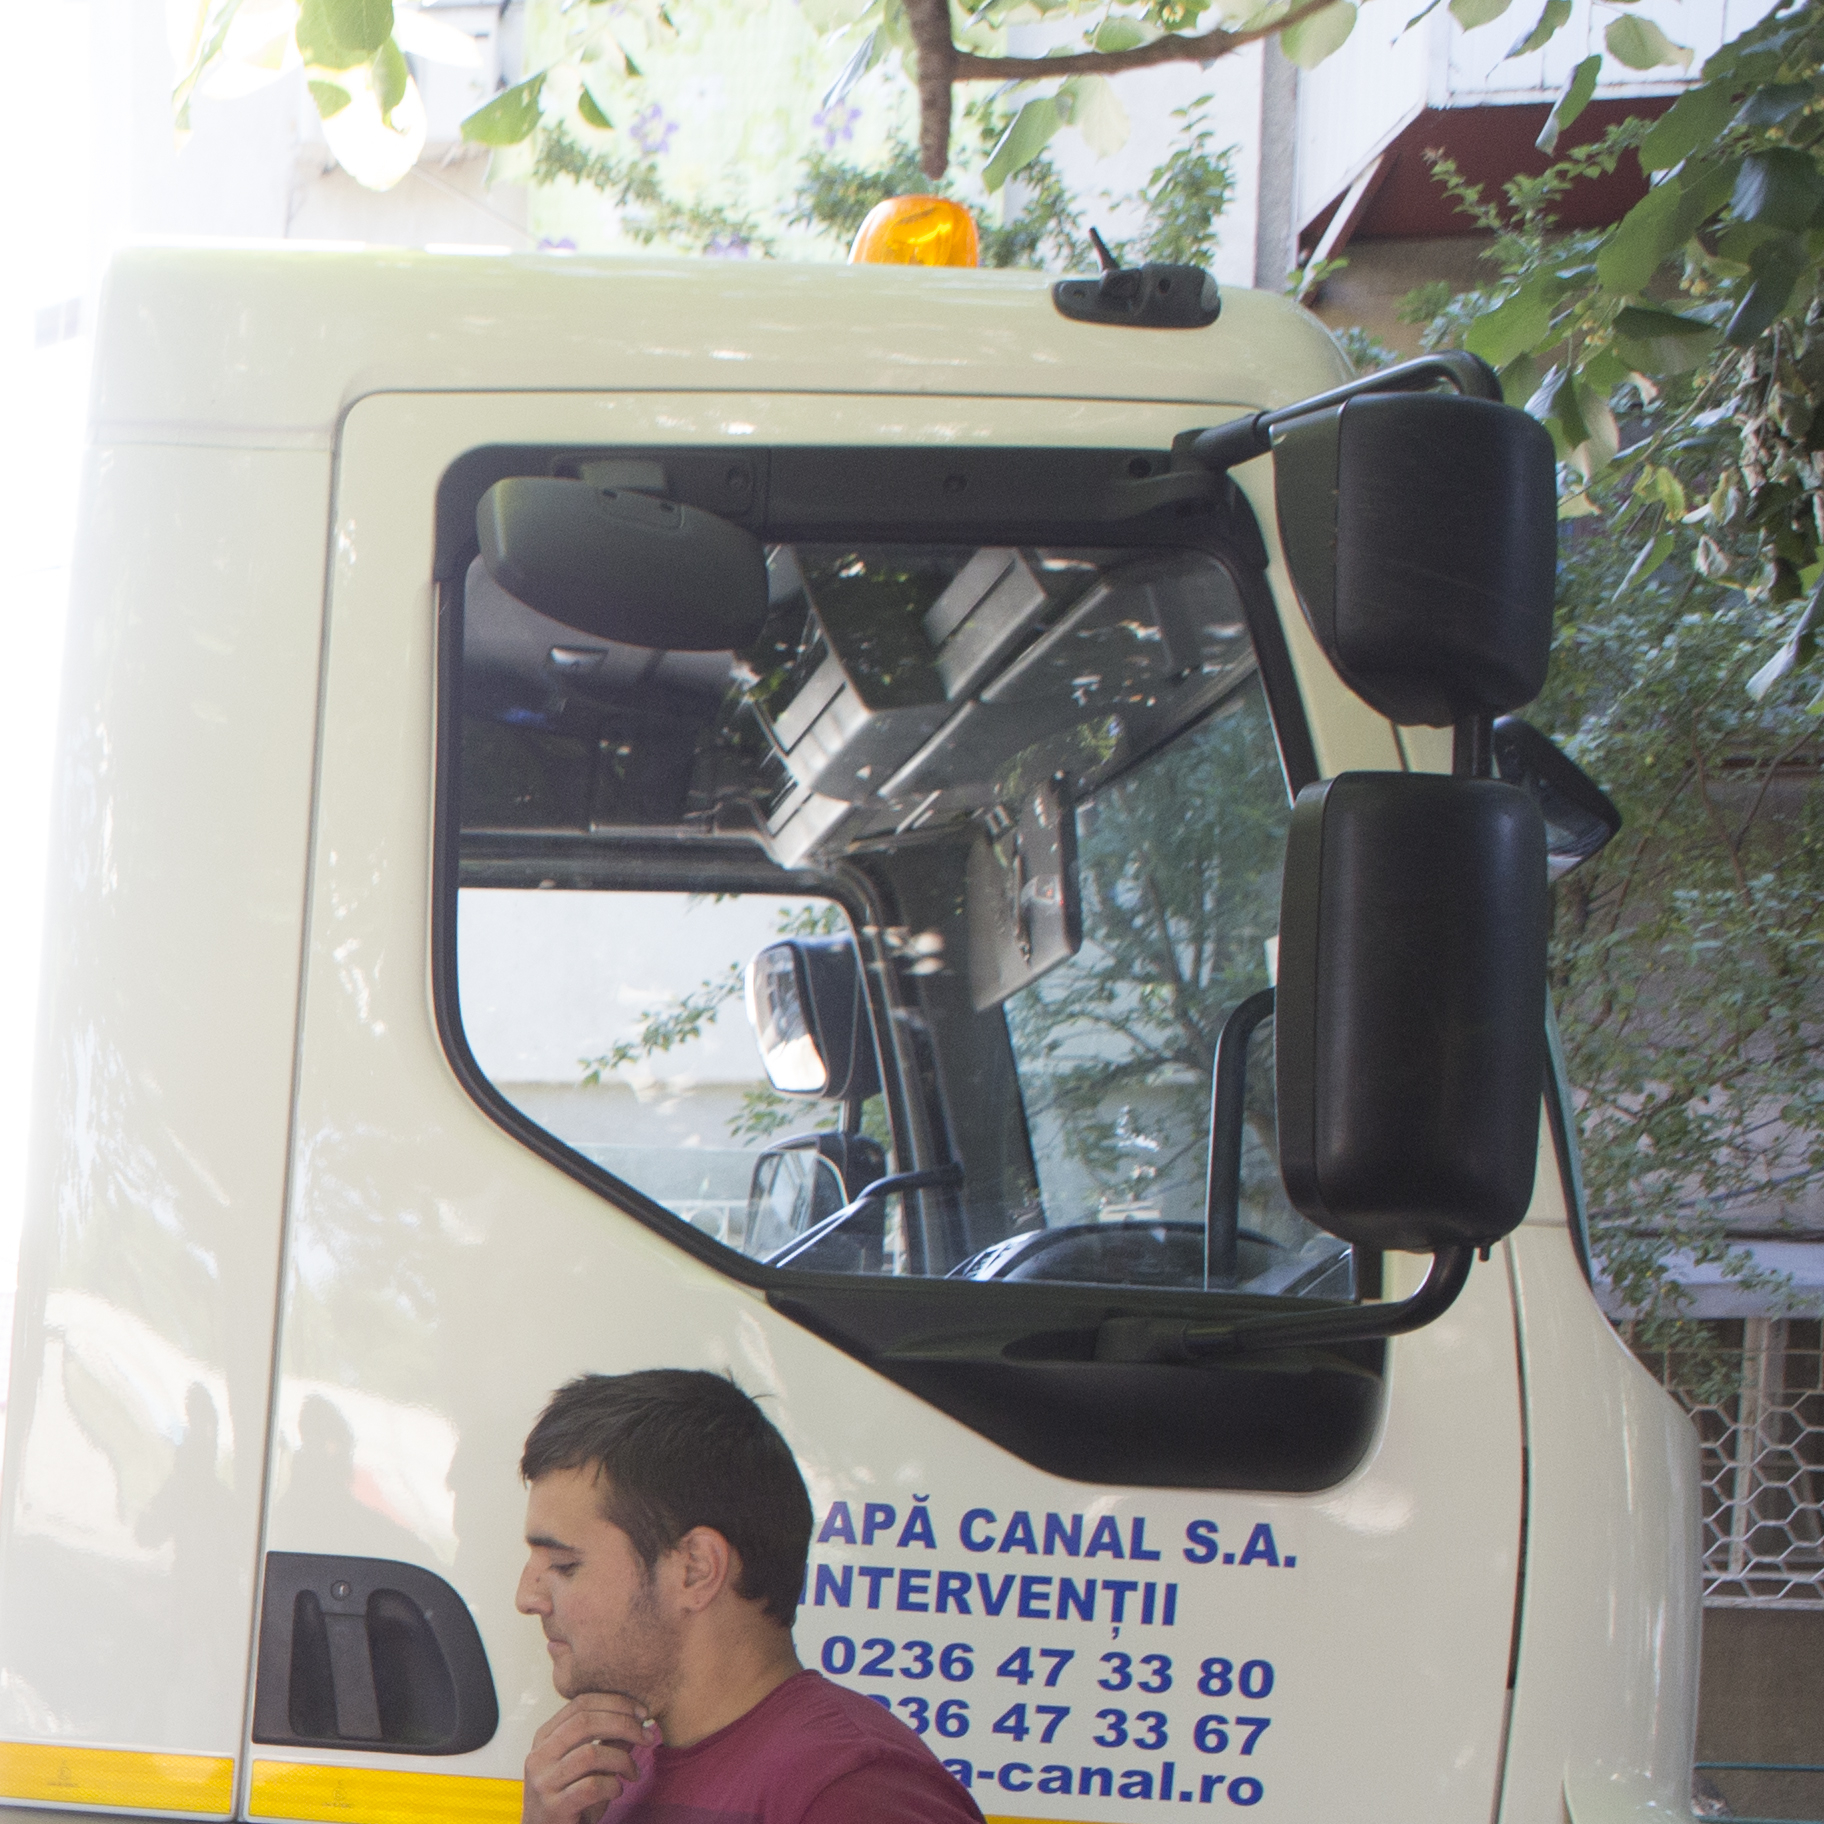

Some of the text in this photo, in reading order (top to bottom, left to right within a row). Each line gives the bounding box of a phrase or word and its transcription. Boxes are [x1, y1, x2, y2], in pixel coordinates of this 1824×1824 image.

[817, 1493, 1298, 1568] APĂ CANAL S.A.
[821, 1634, 1276, 1699] 0236 47 33 80
[867, 1692, 1272, 1756] 36 47 33 67
